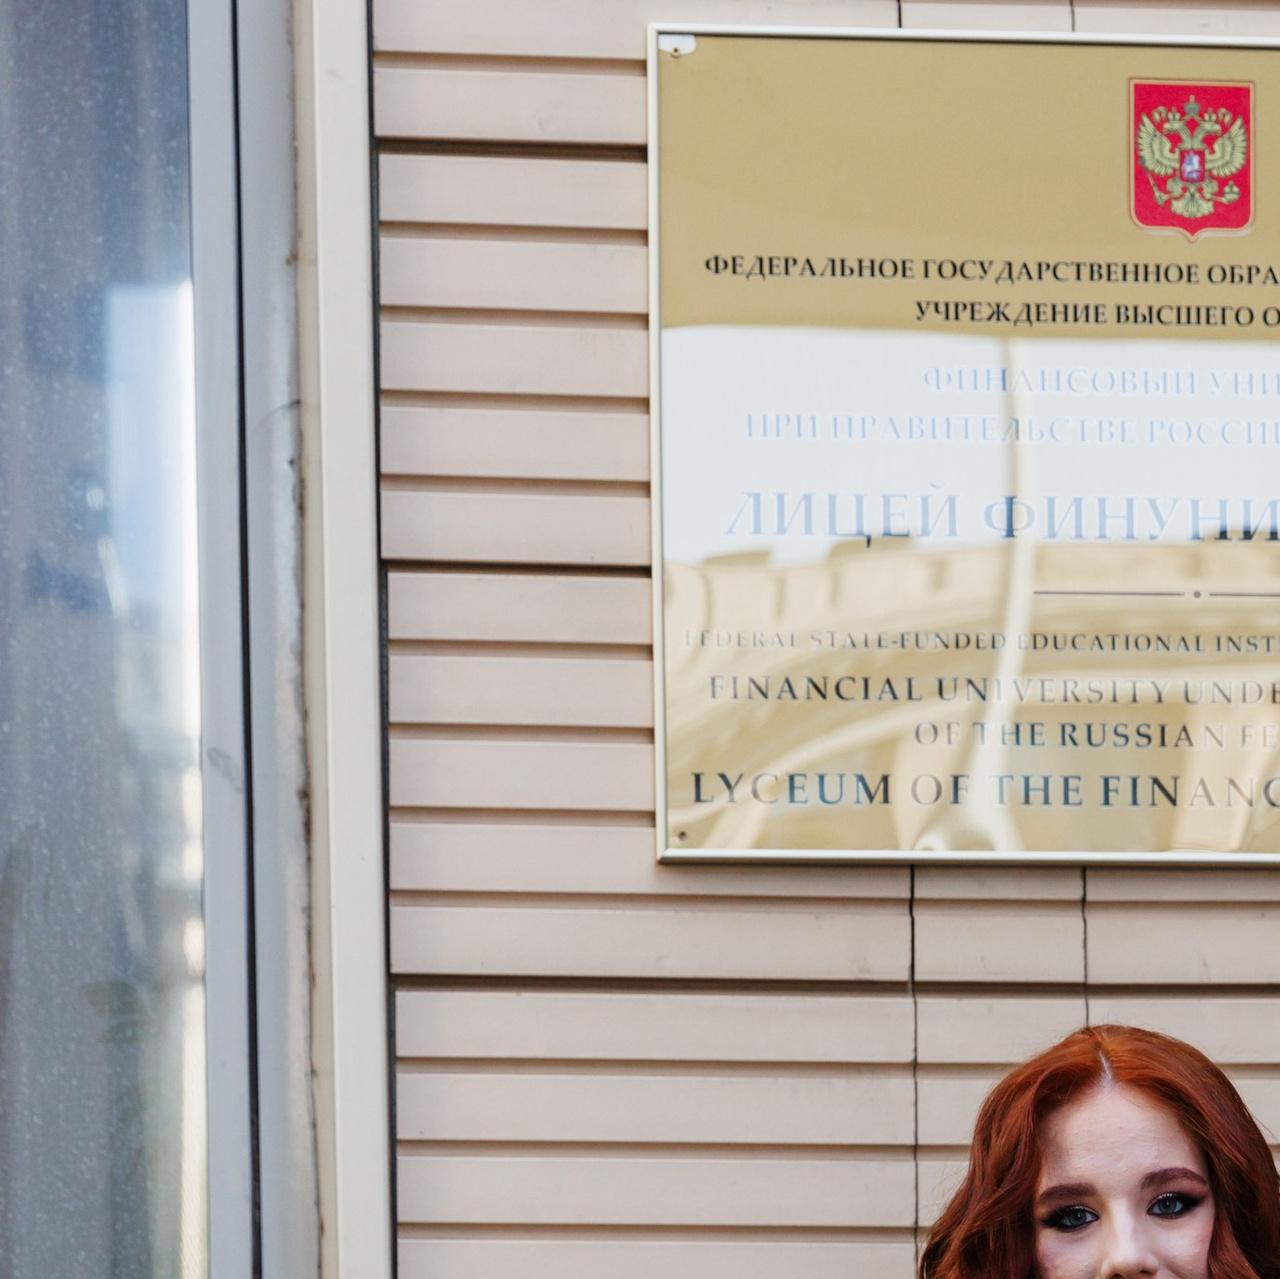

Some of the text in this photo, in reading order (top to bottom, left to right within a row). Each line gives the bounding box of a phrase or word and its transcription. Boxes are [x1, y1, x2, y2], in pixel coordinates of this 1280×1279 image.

[705, 254, 915, 281] ФЕДЕРАЛЬНОЕ
[923, 259, 1199, 285] ГОСУДАРСТВЕННОЕ
[915, 301, 1107, 327] УЧРЕЖДЕНИЕ
[1116, 305, 1254, 328] ВЫСШЕГО
[923, 363, 1197, 396] ФИНАНСОВЫЙ
[746, 412, 818, 440] ПРИ
[832, 414, 1136, 444] ПРАВИТЕЛЬСТВЕ
[723, 482, 960, 549] ЛИЦЕЙ
[685, 629, 799, 649] FEDERAL
[810, 632, 1006, 651] STATE-FUNDED
[1018, 633, 1206, 653] EDUCATIONAL
[709, 675, 923, 702] FINANCIAL
[936, 676, 1170, 704] UNIVERSITY
[915, 720, 960, 746] OF
[972, 721, 1045, 746] THE
[1059, 722, 1225, 749] RUSSIAN
[691, 771, 892, 806] LYCEUM
[910, 773, 970, 806] OF
[987, 774, 1083, 807] THE
